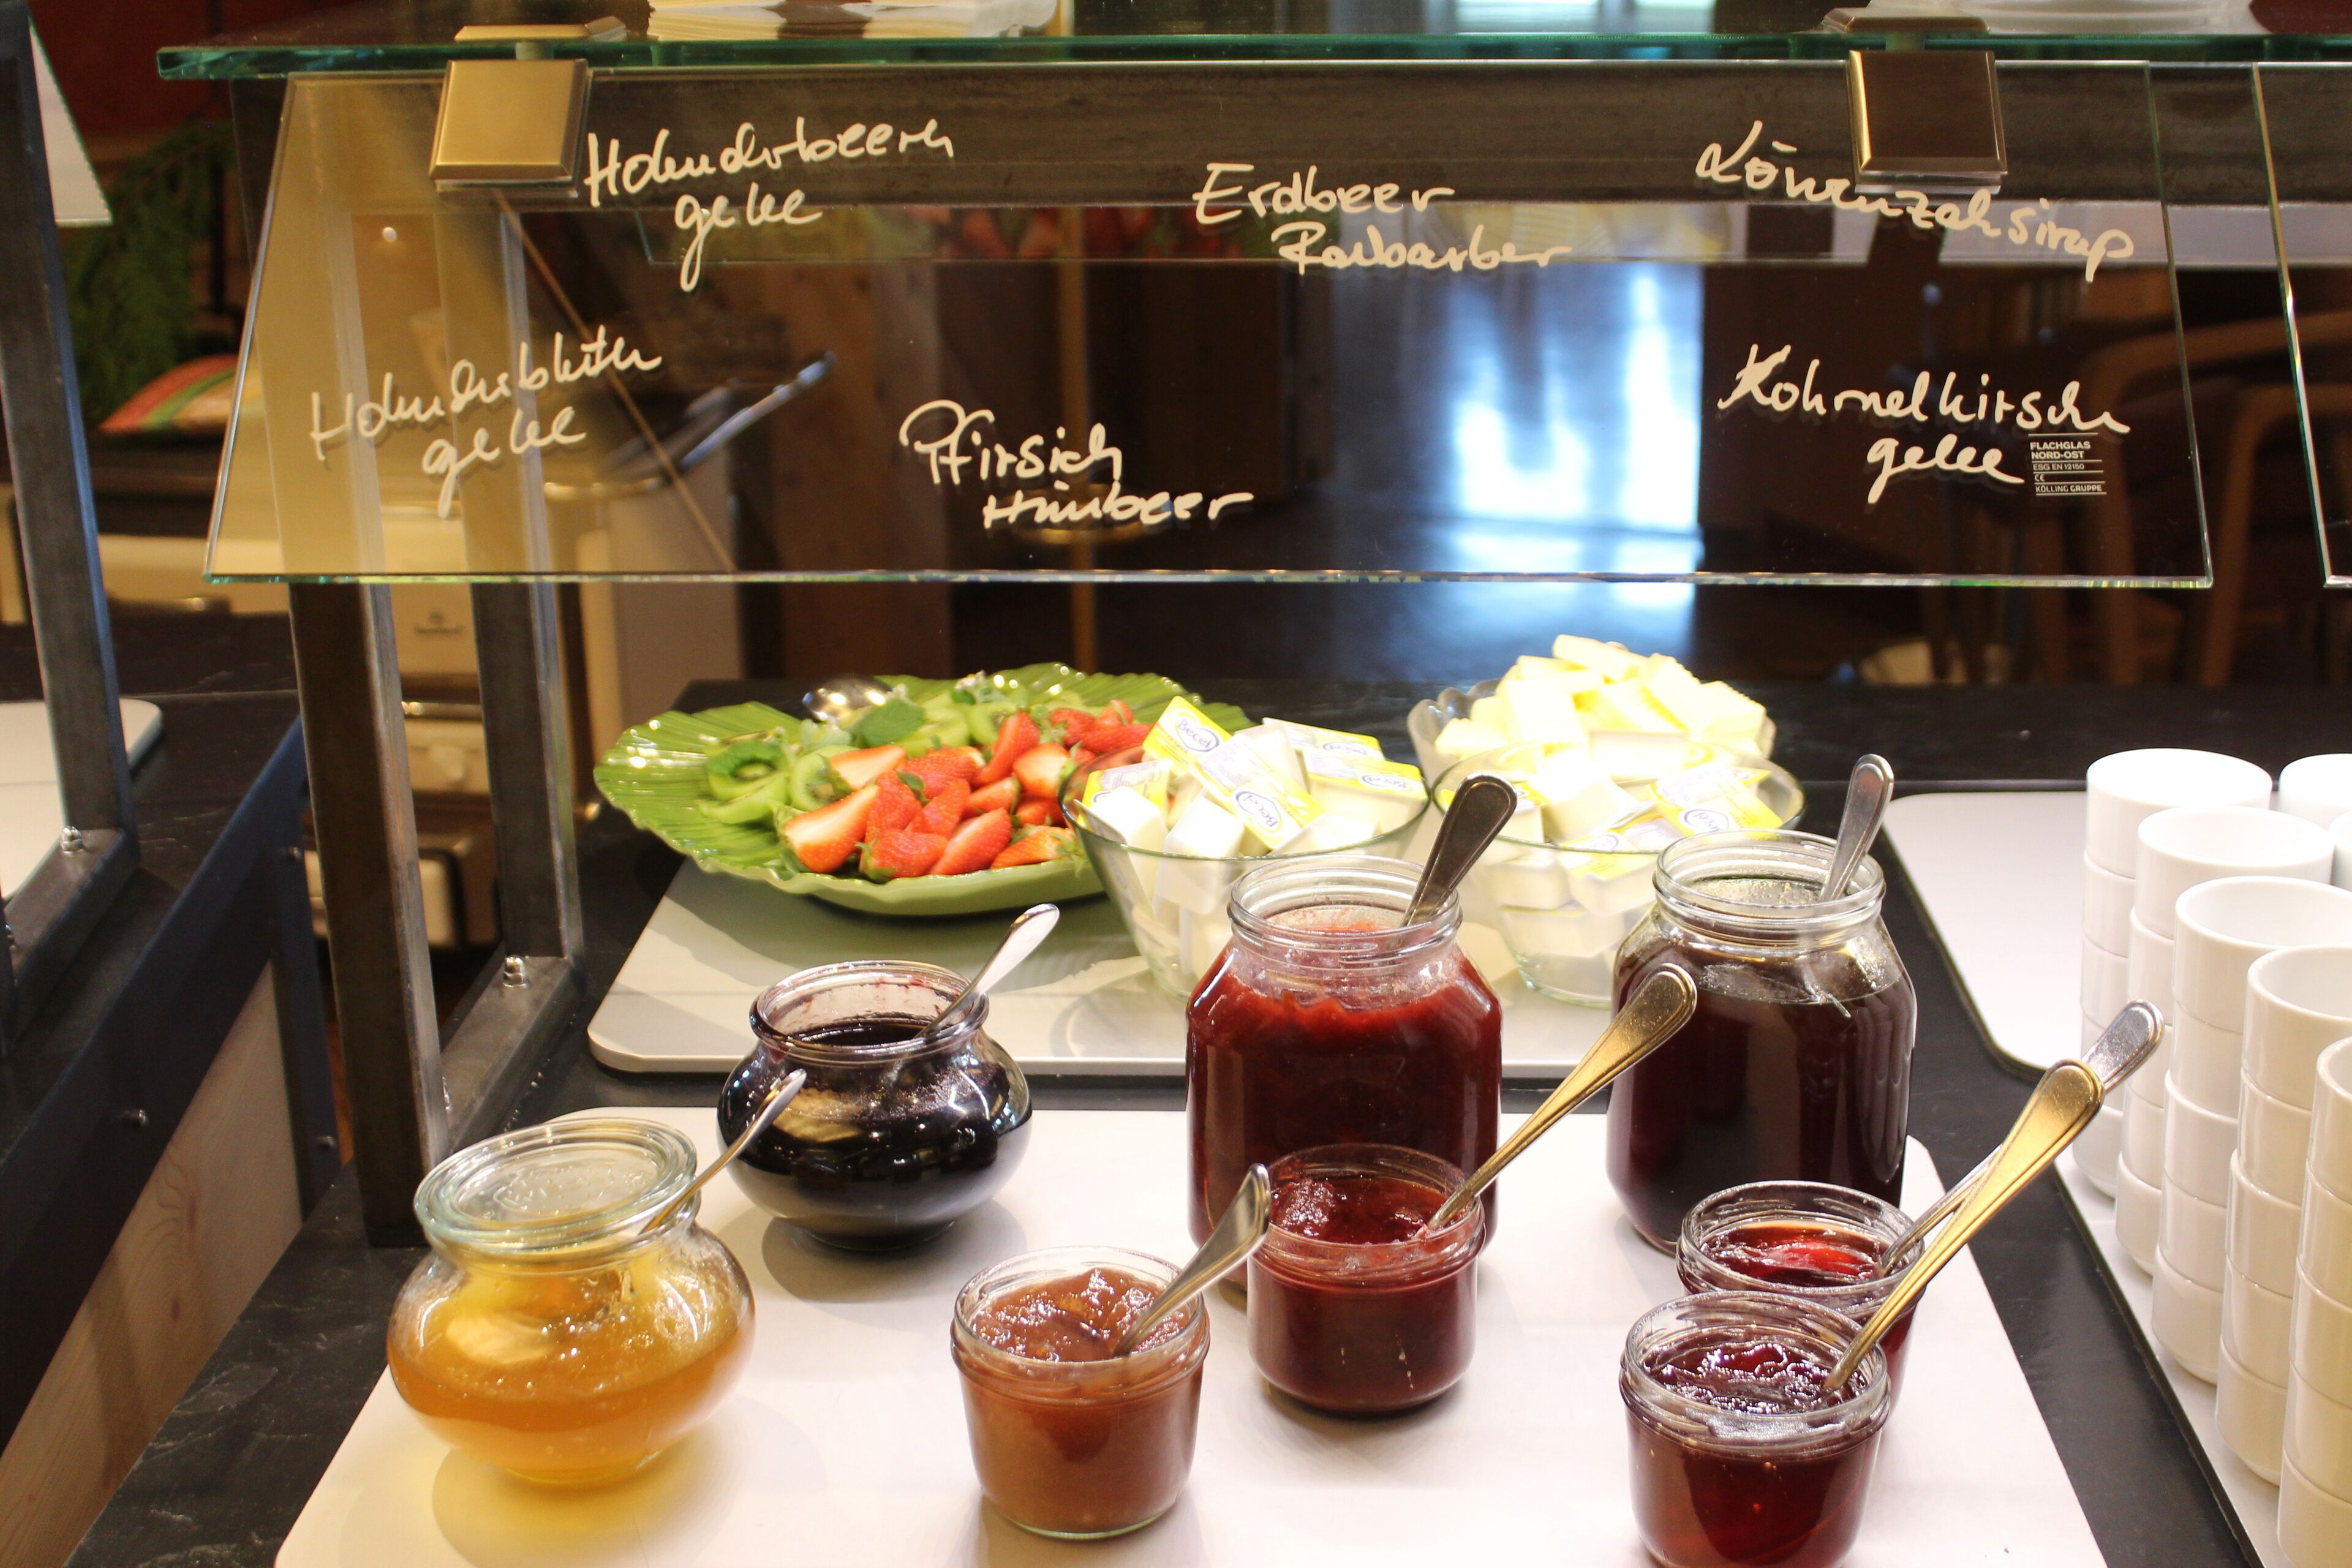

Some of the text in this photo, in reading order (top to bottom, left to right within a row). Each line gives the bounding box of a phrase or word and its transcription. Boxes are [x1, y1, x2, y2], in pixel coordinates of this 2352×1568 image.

[1192, 162, 1455, 225] Erdbeer
[899, 399, 1123, 486] Pfirsich
[1866, 433, 2026, 505] gelee
[2029, 440, 2091, 450] FLACHGLAS
[2030, 450, 2084, 459] NORD-OST
